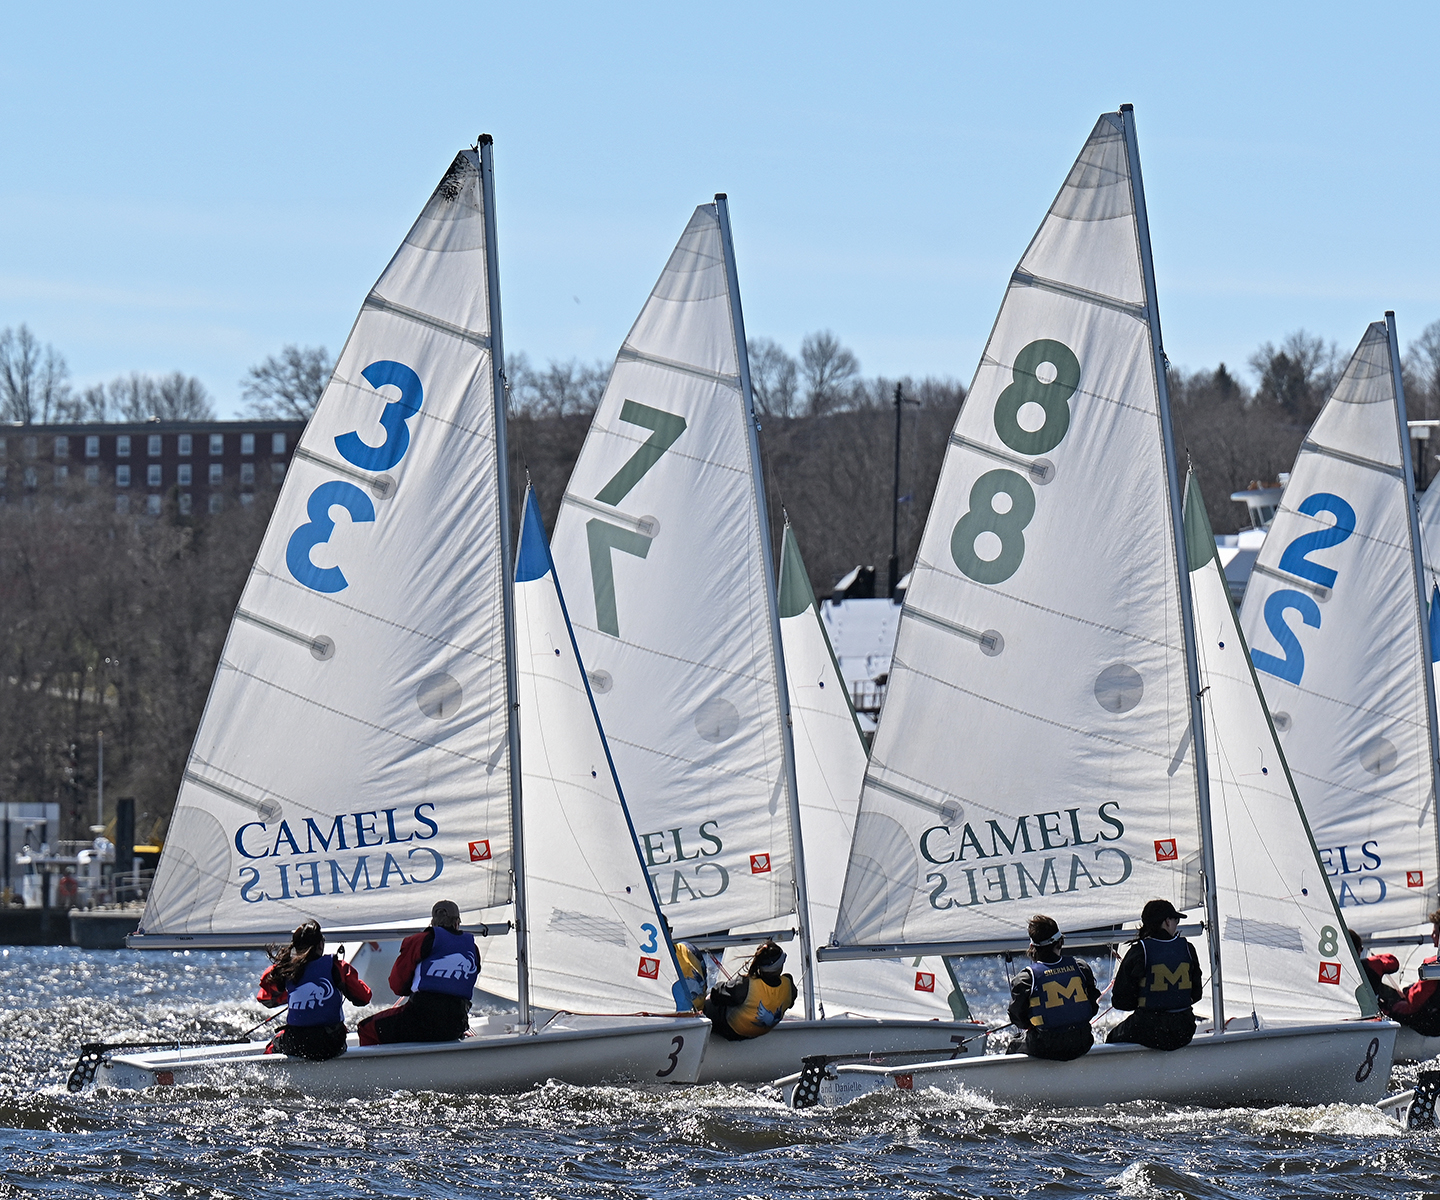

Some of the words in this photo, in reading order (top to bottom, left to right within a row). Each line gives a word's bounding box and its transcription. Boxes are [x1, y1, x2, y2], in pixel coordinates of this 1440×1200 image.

[334, 360, 424, 472] 3
[993, 338, 1081, 456] 8
[594, 399, 687, 507] 7
[1278, 492, 1357, 590] 2
[234, 802, 439, 859] CAMELS
[639, 820, 723, 867] ELS
[919, 801, 1124, 864] CAMELS
[1318, 840, 1382, 876] ELS
[639, 923, 659, 953] 3
[1318, 925, 1339, 956] 8
[1042, 976, 1088, 1009] M
[1044, 965, 1075, 977] SHERMAN
[1150, 962, 1193, 992] M
[656, 1035, 685, 1077] 3
[1354, 1037, 1380, 1084] 8
[821, 1084, 832, 1093] and
[835, 1081, 862, 1092] Danielle
